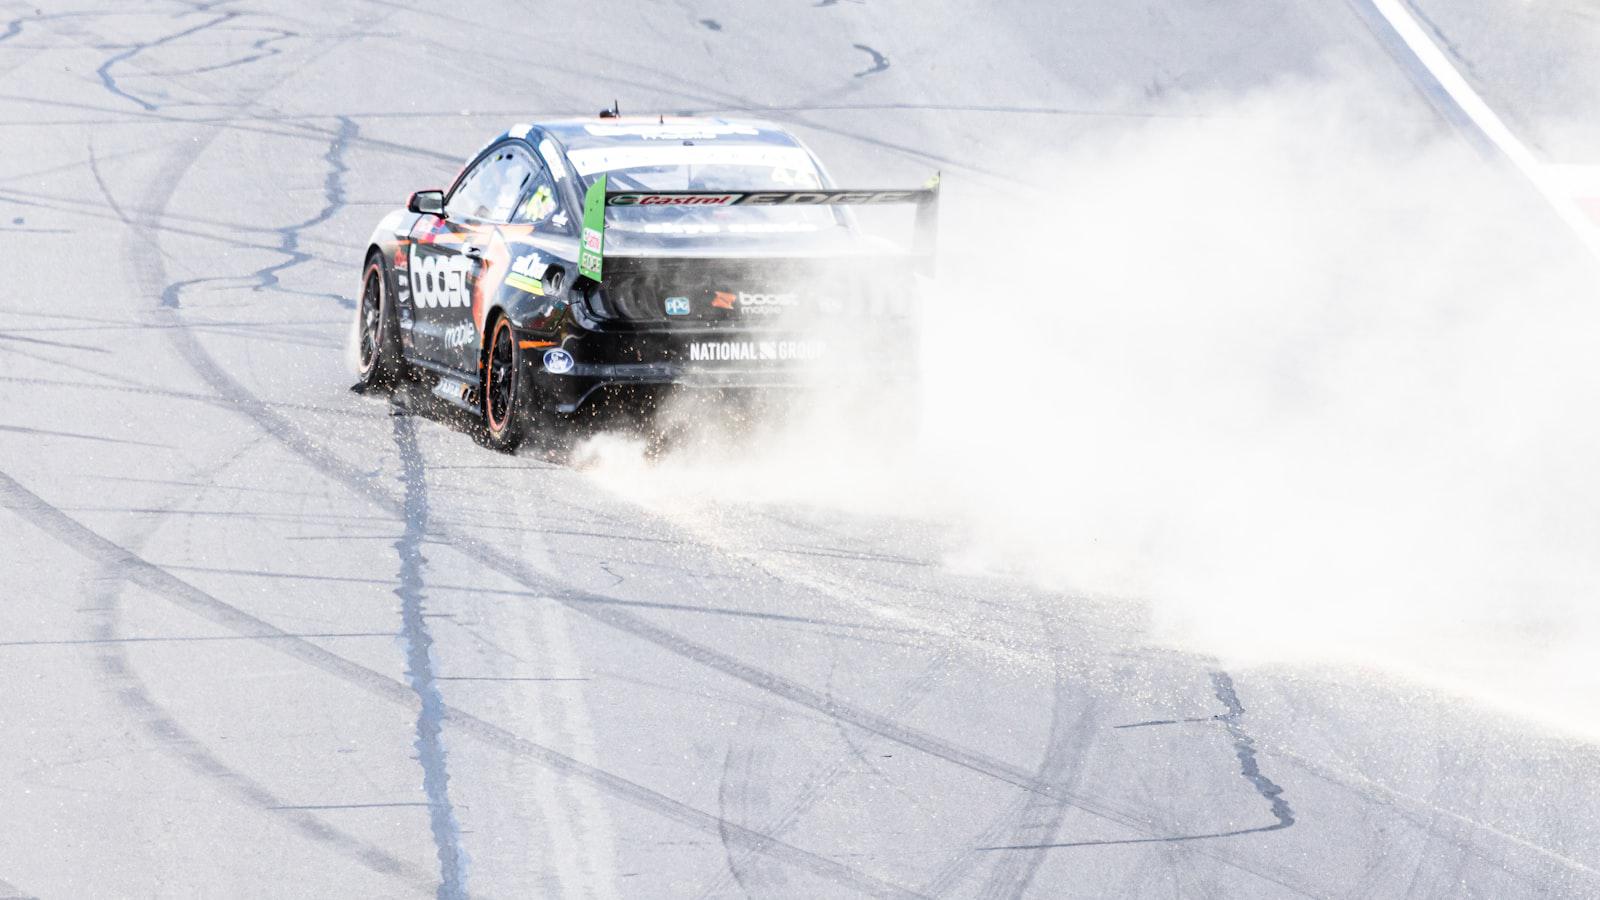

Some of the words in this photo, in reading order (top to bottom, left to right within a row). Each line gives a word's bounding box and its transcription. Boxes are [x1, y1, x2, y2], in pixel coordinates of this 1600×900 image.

[639, 195, 732, 206] Castrol
[741, 192, 912, 206] EDGE
[410, 243, 472, 309] boost
[739, 291, 799, 305] boost
[741, 304, 782, 314] mobile
[446, 320, 474, 348] mobile
[690, 343, 757, 361] NATIONAL
